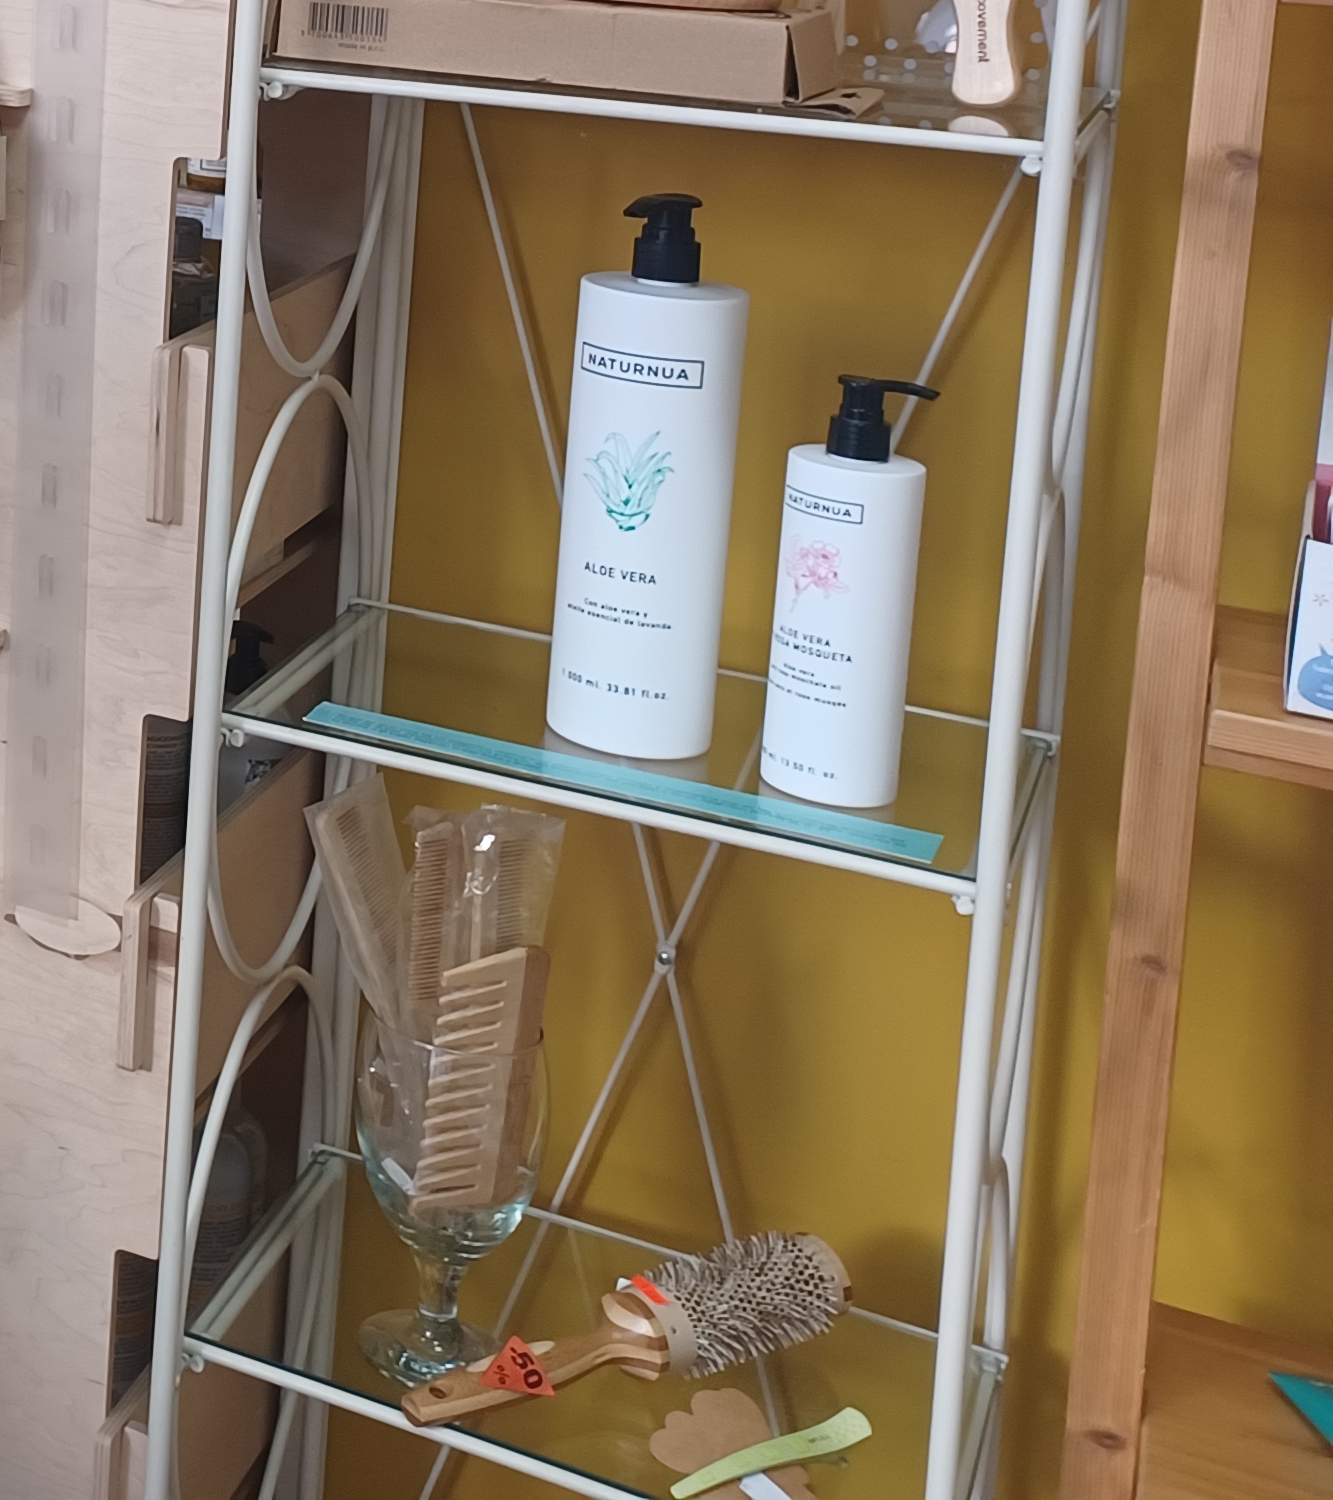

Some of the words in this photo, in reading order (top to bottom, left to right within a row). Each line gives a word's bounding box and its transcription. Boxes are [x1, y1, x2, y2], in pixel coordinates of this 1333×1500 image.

[587, 352, 691, 383] NATURNUA
[584, 562, 615, 579] ALOE
[620, 570, 657, 585] VERA
[779, 624, 799, 639] ALOE
[803, 632, 831, 648] VERA
[492, 1364, 511, 1385] %
[509, 1346, 544, 1390] -50
